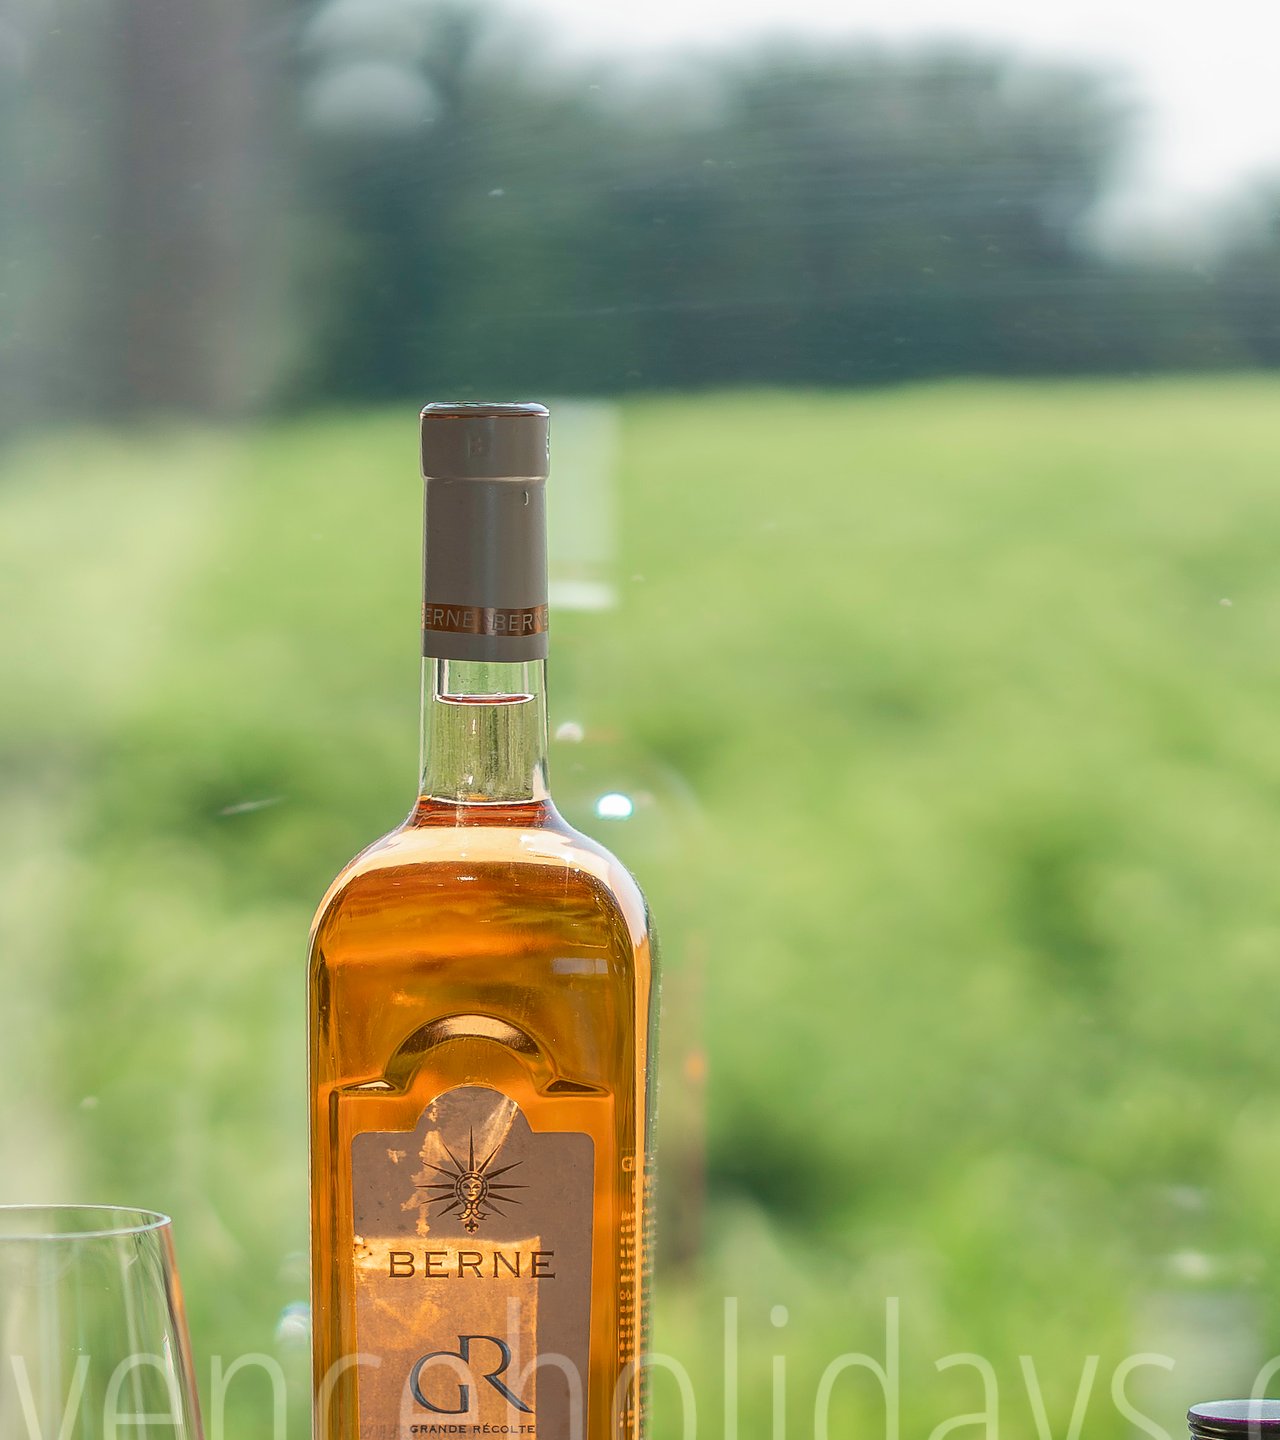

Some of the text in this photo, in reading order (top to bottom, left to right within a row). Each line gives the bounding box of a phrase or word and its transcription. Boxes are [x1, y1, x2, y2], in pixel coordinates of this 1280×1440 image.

[388, 1251, 556, 1279] BERNE
[410, 1422, 536, 1434] GRANDE RÉCOLTE
